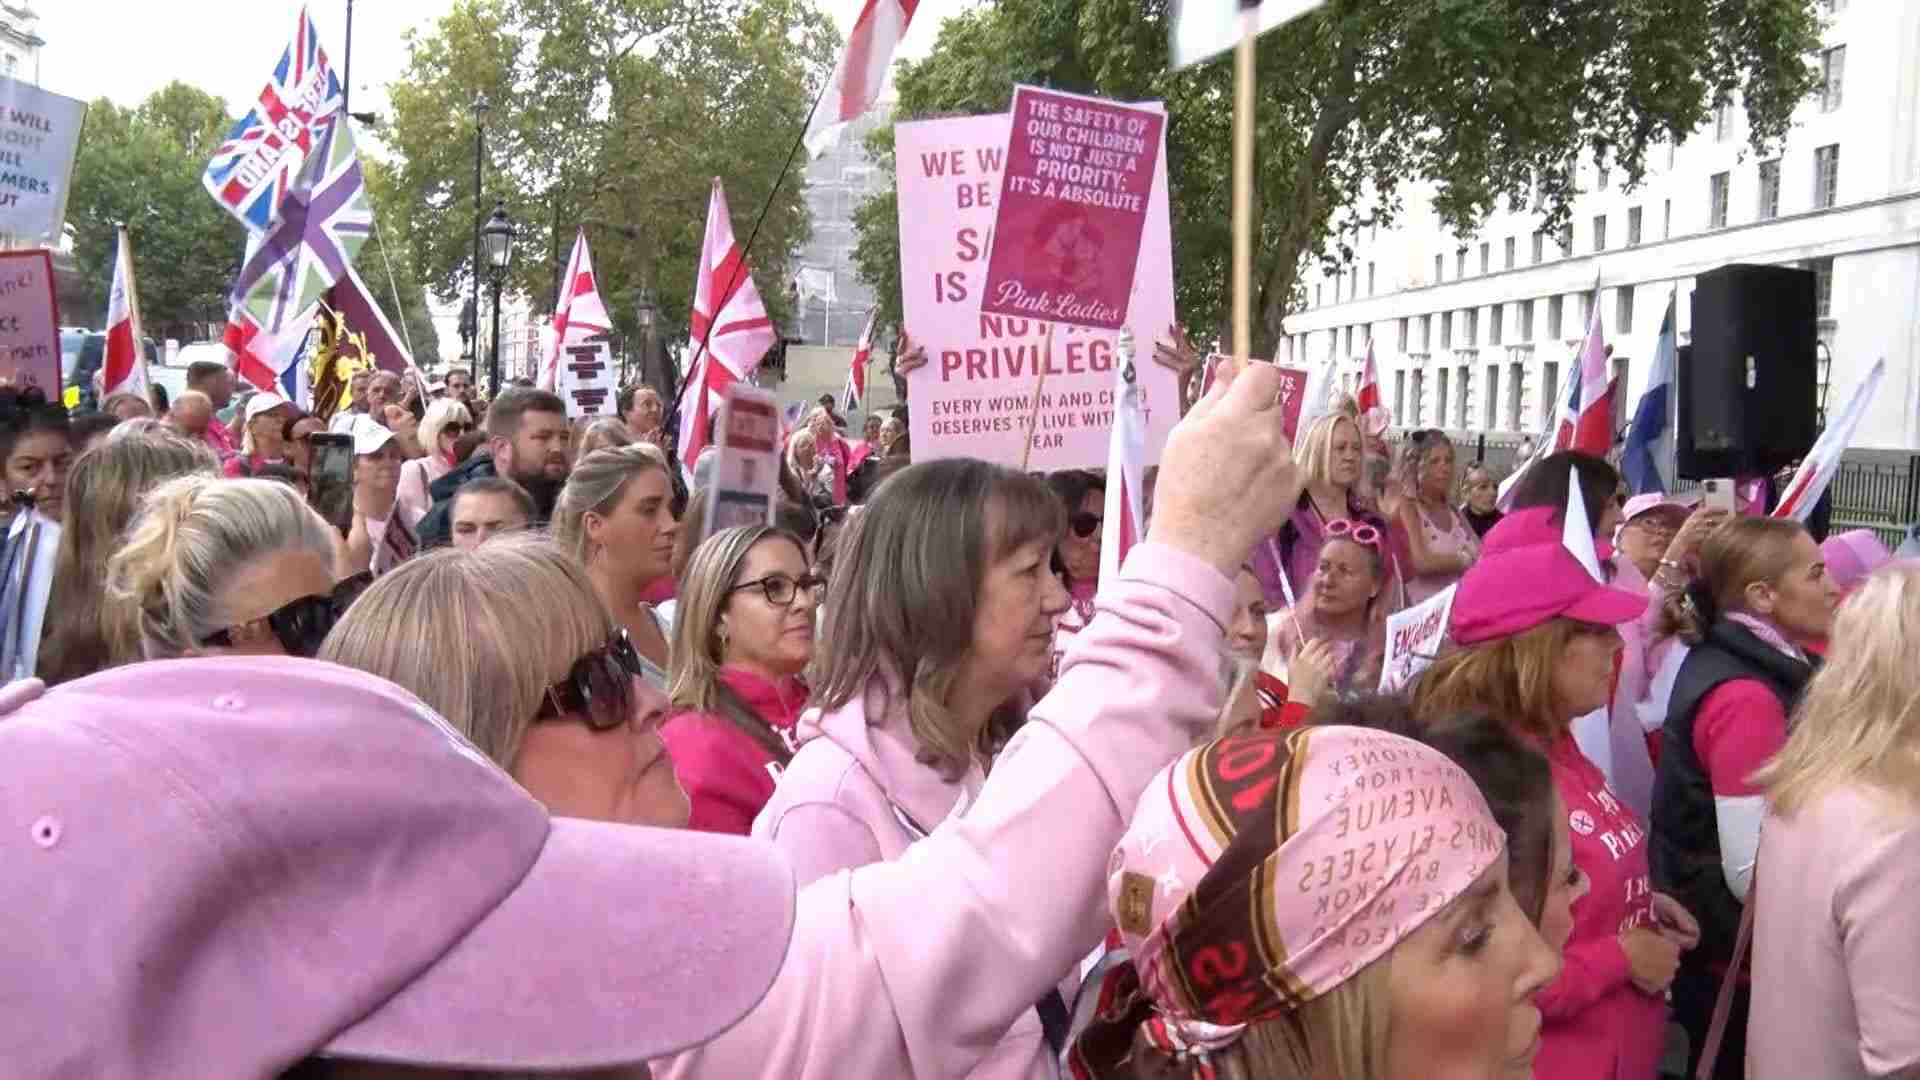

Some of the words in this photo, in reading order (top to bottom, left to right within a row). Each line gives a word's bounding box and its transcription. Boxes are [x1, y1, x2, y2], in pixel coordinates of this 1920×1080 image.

[1028, 100, 1059, 119] THE
[1063, 106, 1125, 130] SAFETY
[1127, 117, 1148, 136] OF
[1027, 119, 1062, 138] OUR
[1066, 126, 1145, 155] CHILDREN
[921, 150, 966, 178] WE
[1030, 138, 1046, 155] IS
[1050, 142, 1080, 161] NOT
[1084, 148, 1122, 169] JUST
[1125, 156, 1137, 172] A
[0, 171, 49, 195] MERS
[957, 182, 992, 209] BE
[1010, 175, 1040, 196] IT'S
[1044, 182, 1055, 198] A
[1060, 184, 1142, 212] ABSOLUTE
[935, 270, 968, 304] IS
[993, 279, 1050, 318] Pink
[1051, 292, 1120, 322] Ladies
[941, 338, 1120, 382] PRIVILEG
[932, 399, 982, 416] EVERY
[988, 394, 1051, 412] WOMN
[1059, 392, 1093, 408] AND
[931, 417, 1012, 436] DESERVES
[1043, 413, 1077, 430] LIVE
[1033, 433, 1064, 449] EAR
